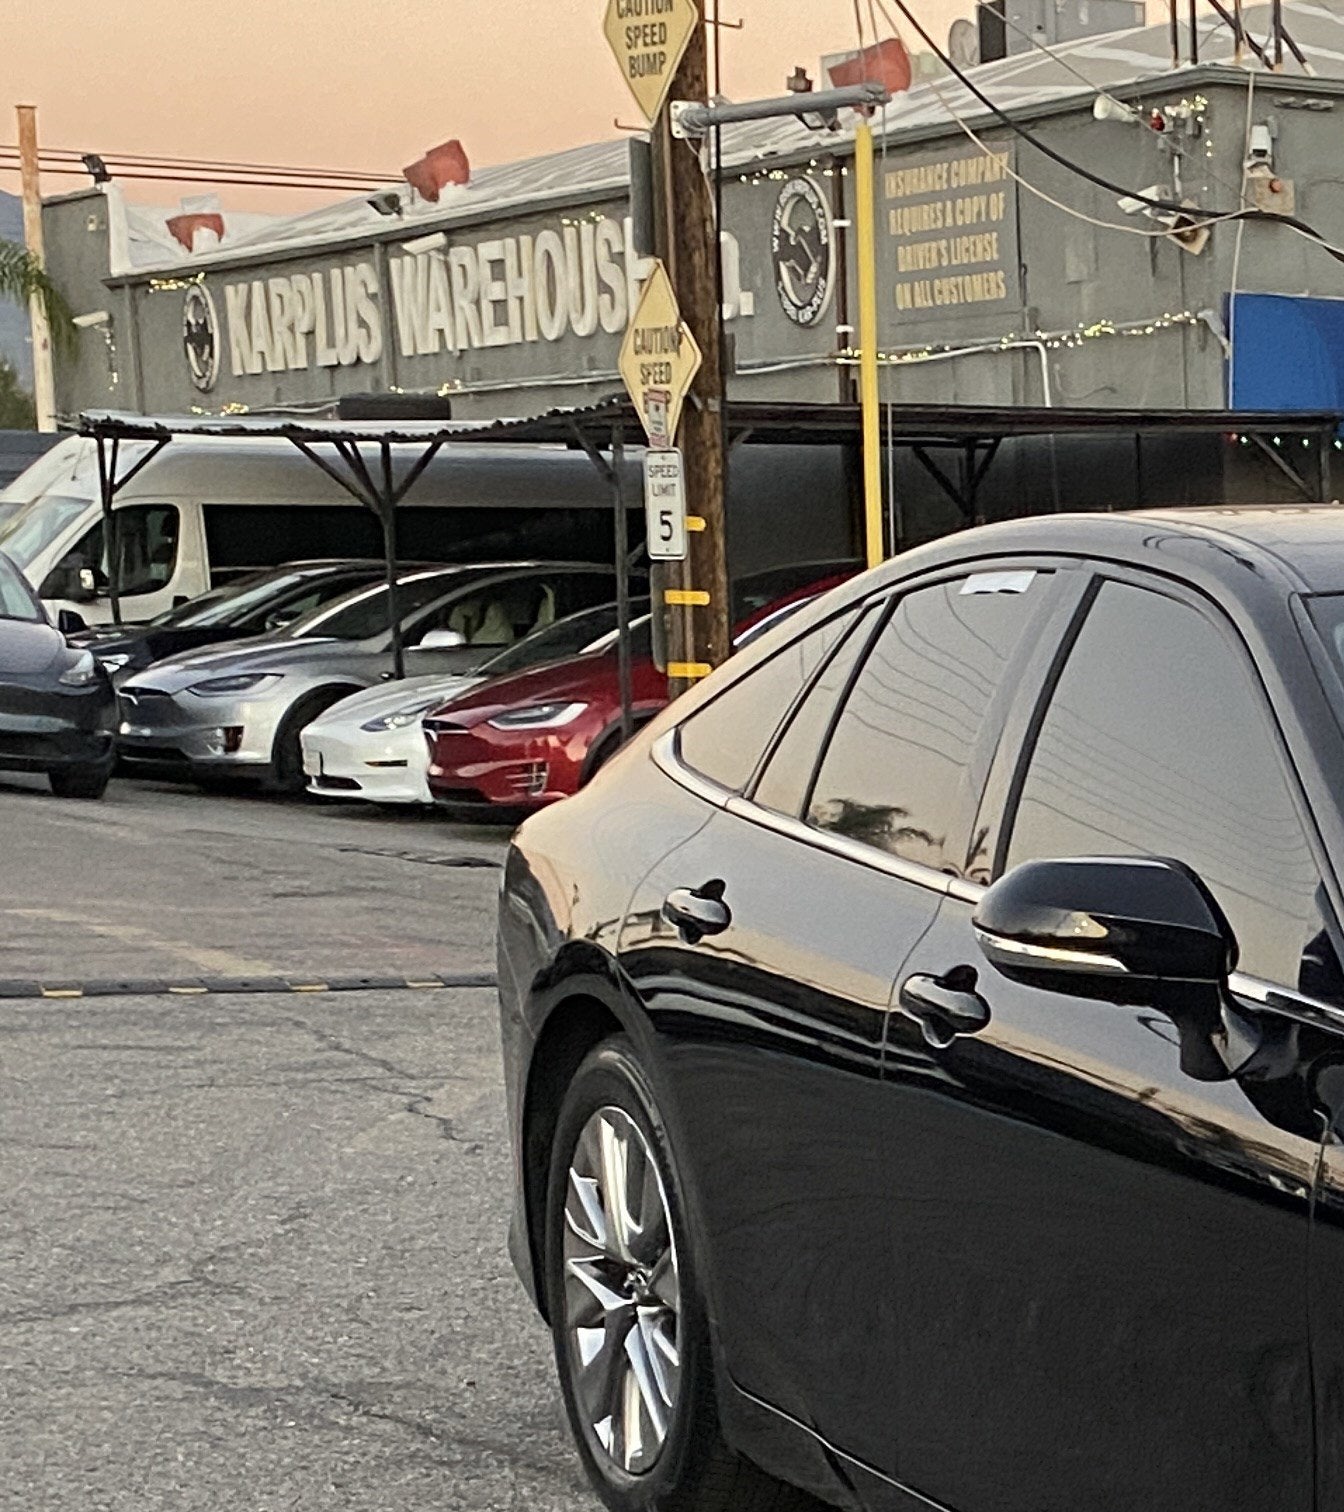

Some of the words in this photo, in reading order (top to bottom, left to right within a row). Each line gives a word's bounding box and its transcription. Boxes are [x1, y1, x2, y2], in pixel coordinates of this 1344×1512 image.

[625, 22, 667, 50] SPEED
[629, 51, 666, 79] BUMP
[885, 163, 949, 199] INSURANCE
[951, 152, 1009, 188] COMPANY
[889, 202, 943, 236] REQUIRES
[945, 200, 954, 227] A
[955, 195, 988, 226] COPY
[989, 191, 1005, 221] OF
[897, 239, 949, 272] DRIVER'S
[950, 232, 999, 265] LICENSE
[895, 283, 912, 310] ON
[914, 280, 934, 308] ALL
[934, 270, 1006, 306] CUSTOMERS
[224, 263, 382, 377] KARPLUS
[634, 325, 681, 356] CAUTION
[640, 361, 672, 386] SPEED
[649, 464, 678, 479] SPEED
[652, 483, 676, 498] LIMIT
[659, 510, 673, 542] 5
